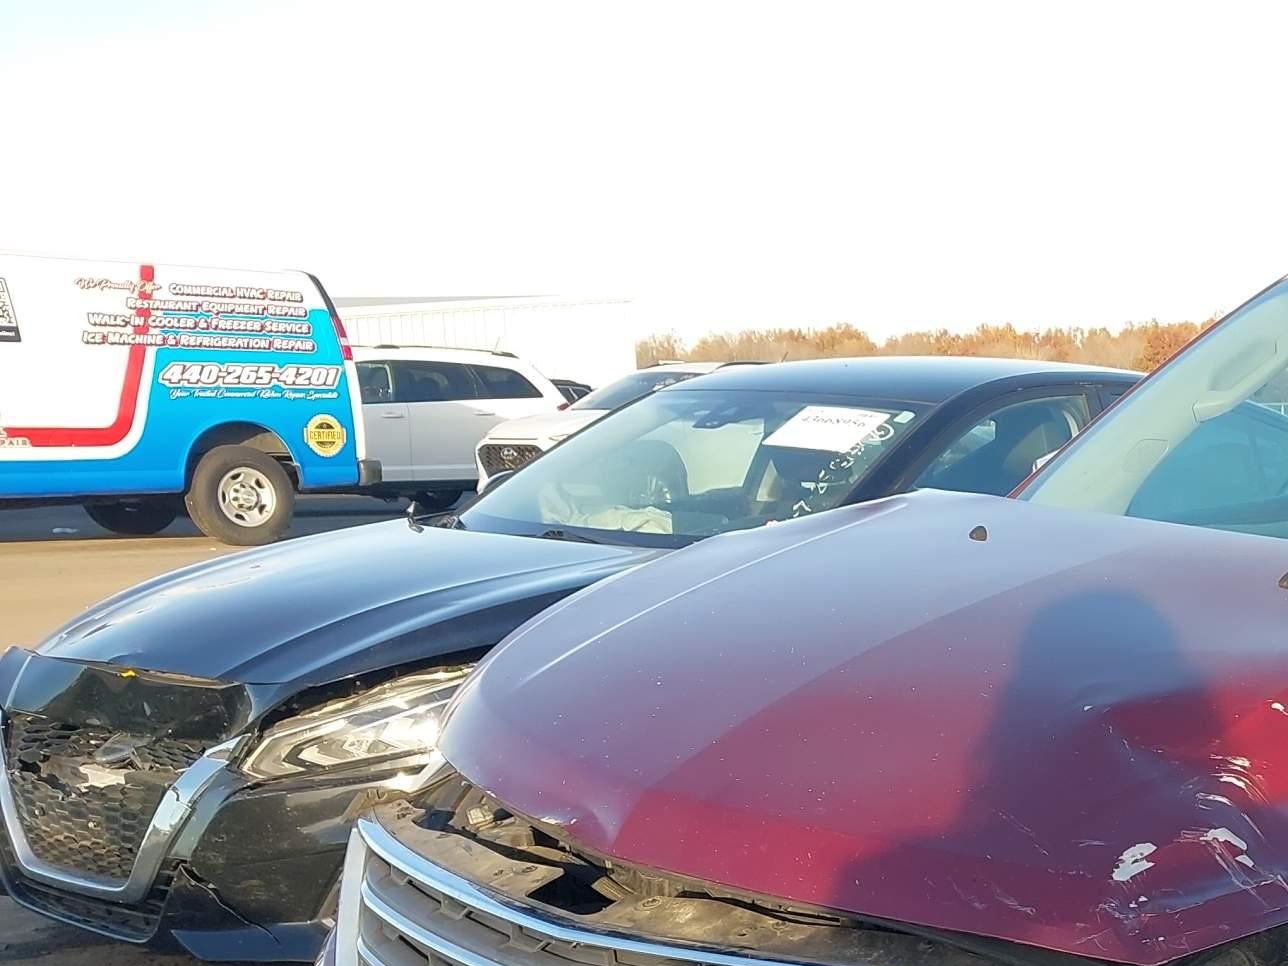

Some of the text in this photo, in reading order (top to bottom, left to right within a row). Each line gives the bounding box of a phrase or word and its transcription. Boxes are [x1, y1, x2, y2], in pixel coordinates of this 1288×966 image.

[169, 283, 303, 302] COMMERCIAL HVAC REPAIR
[126, 297, 307, 317] RESTAURANT EQUIPMENT REPAIR
[88, 313, 311, 334] WALK-IN COOLER & FREEZER SERVICE
[82, 331, 316, 352] ICE MACHINE & REFRIGERATION REPAIR
[161, 363, 340, 387] 440-265-4201
[310, 431, 341, 440] CERTIFIED
